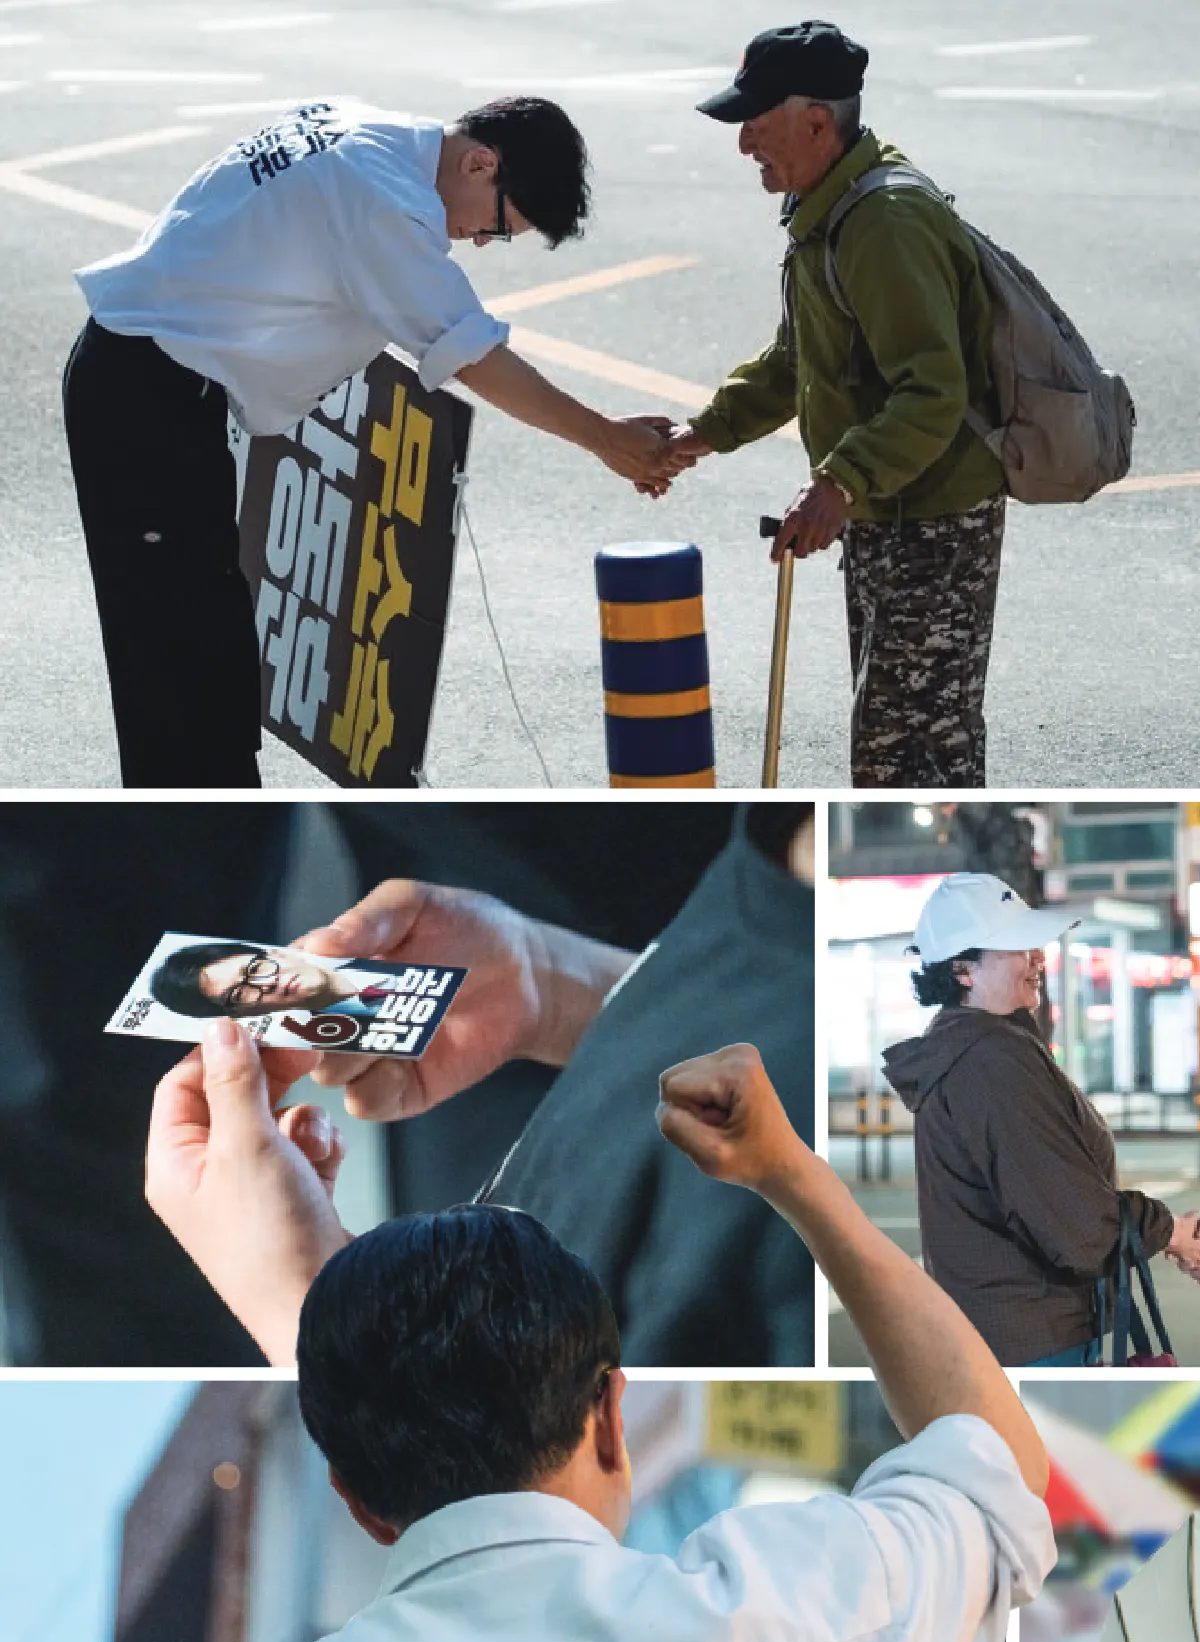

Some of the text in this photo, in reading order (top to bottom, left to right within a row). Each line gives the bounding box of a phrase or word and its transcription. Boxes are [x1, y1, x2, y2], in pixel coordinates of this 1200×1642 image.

[329, 382, 433, 782] 무소속
[280, 1013, 361, 1046] 6
[358, 967, 454, 1052] 한동훈
